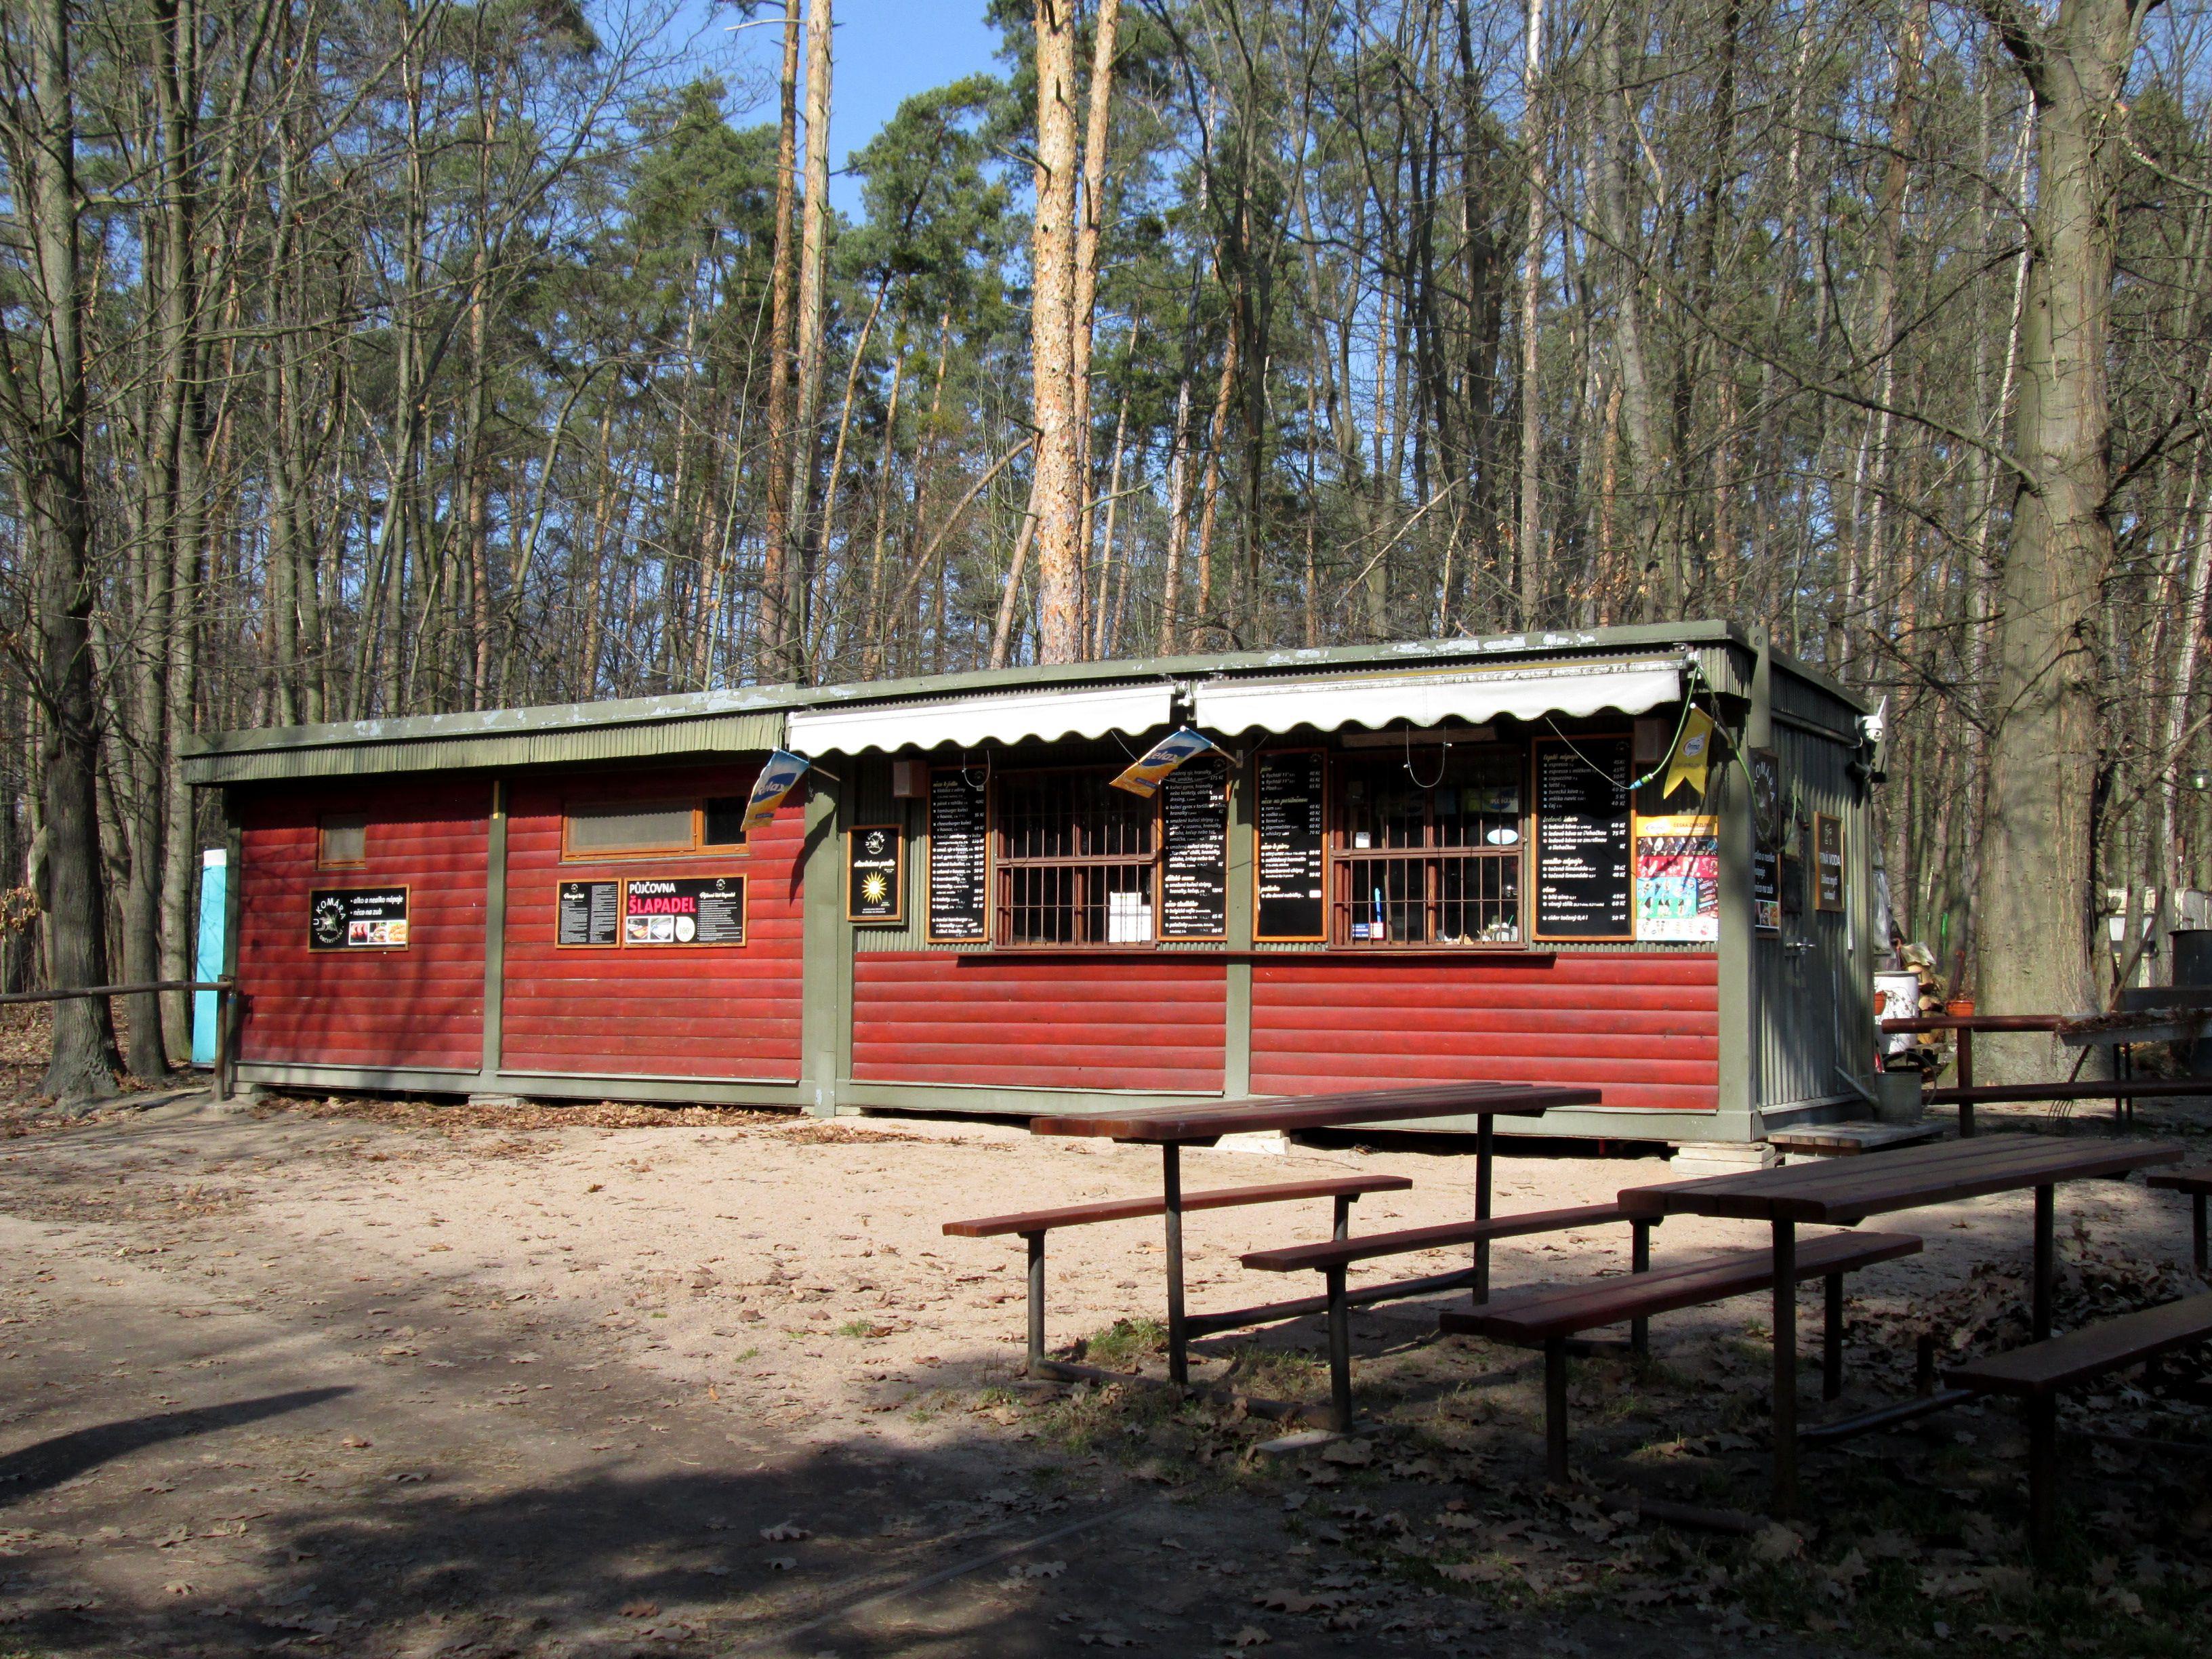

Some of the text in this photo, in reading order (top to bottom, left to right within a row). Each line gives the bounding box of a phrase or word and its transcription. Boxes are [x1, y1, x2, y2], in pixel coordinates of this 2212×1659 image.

[629, 882, 676, 894] PŮJČOVNA
[386, 895, 403, 905] nápoje
[629, 895, 695, 914] ŠLAPADEL
[316, 898, 346, 920] KOMÁRA
